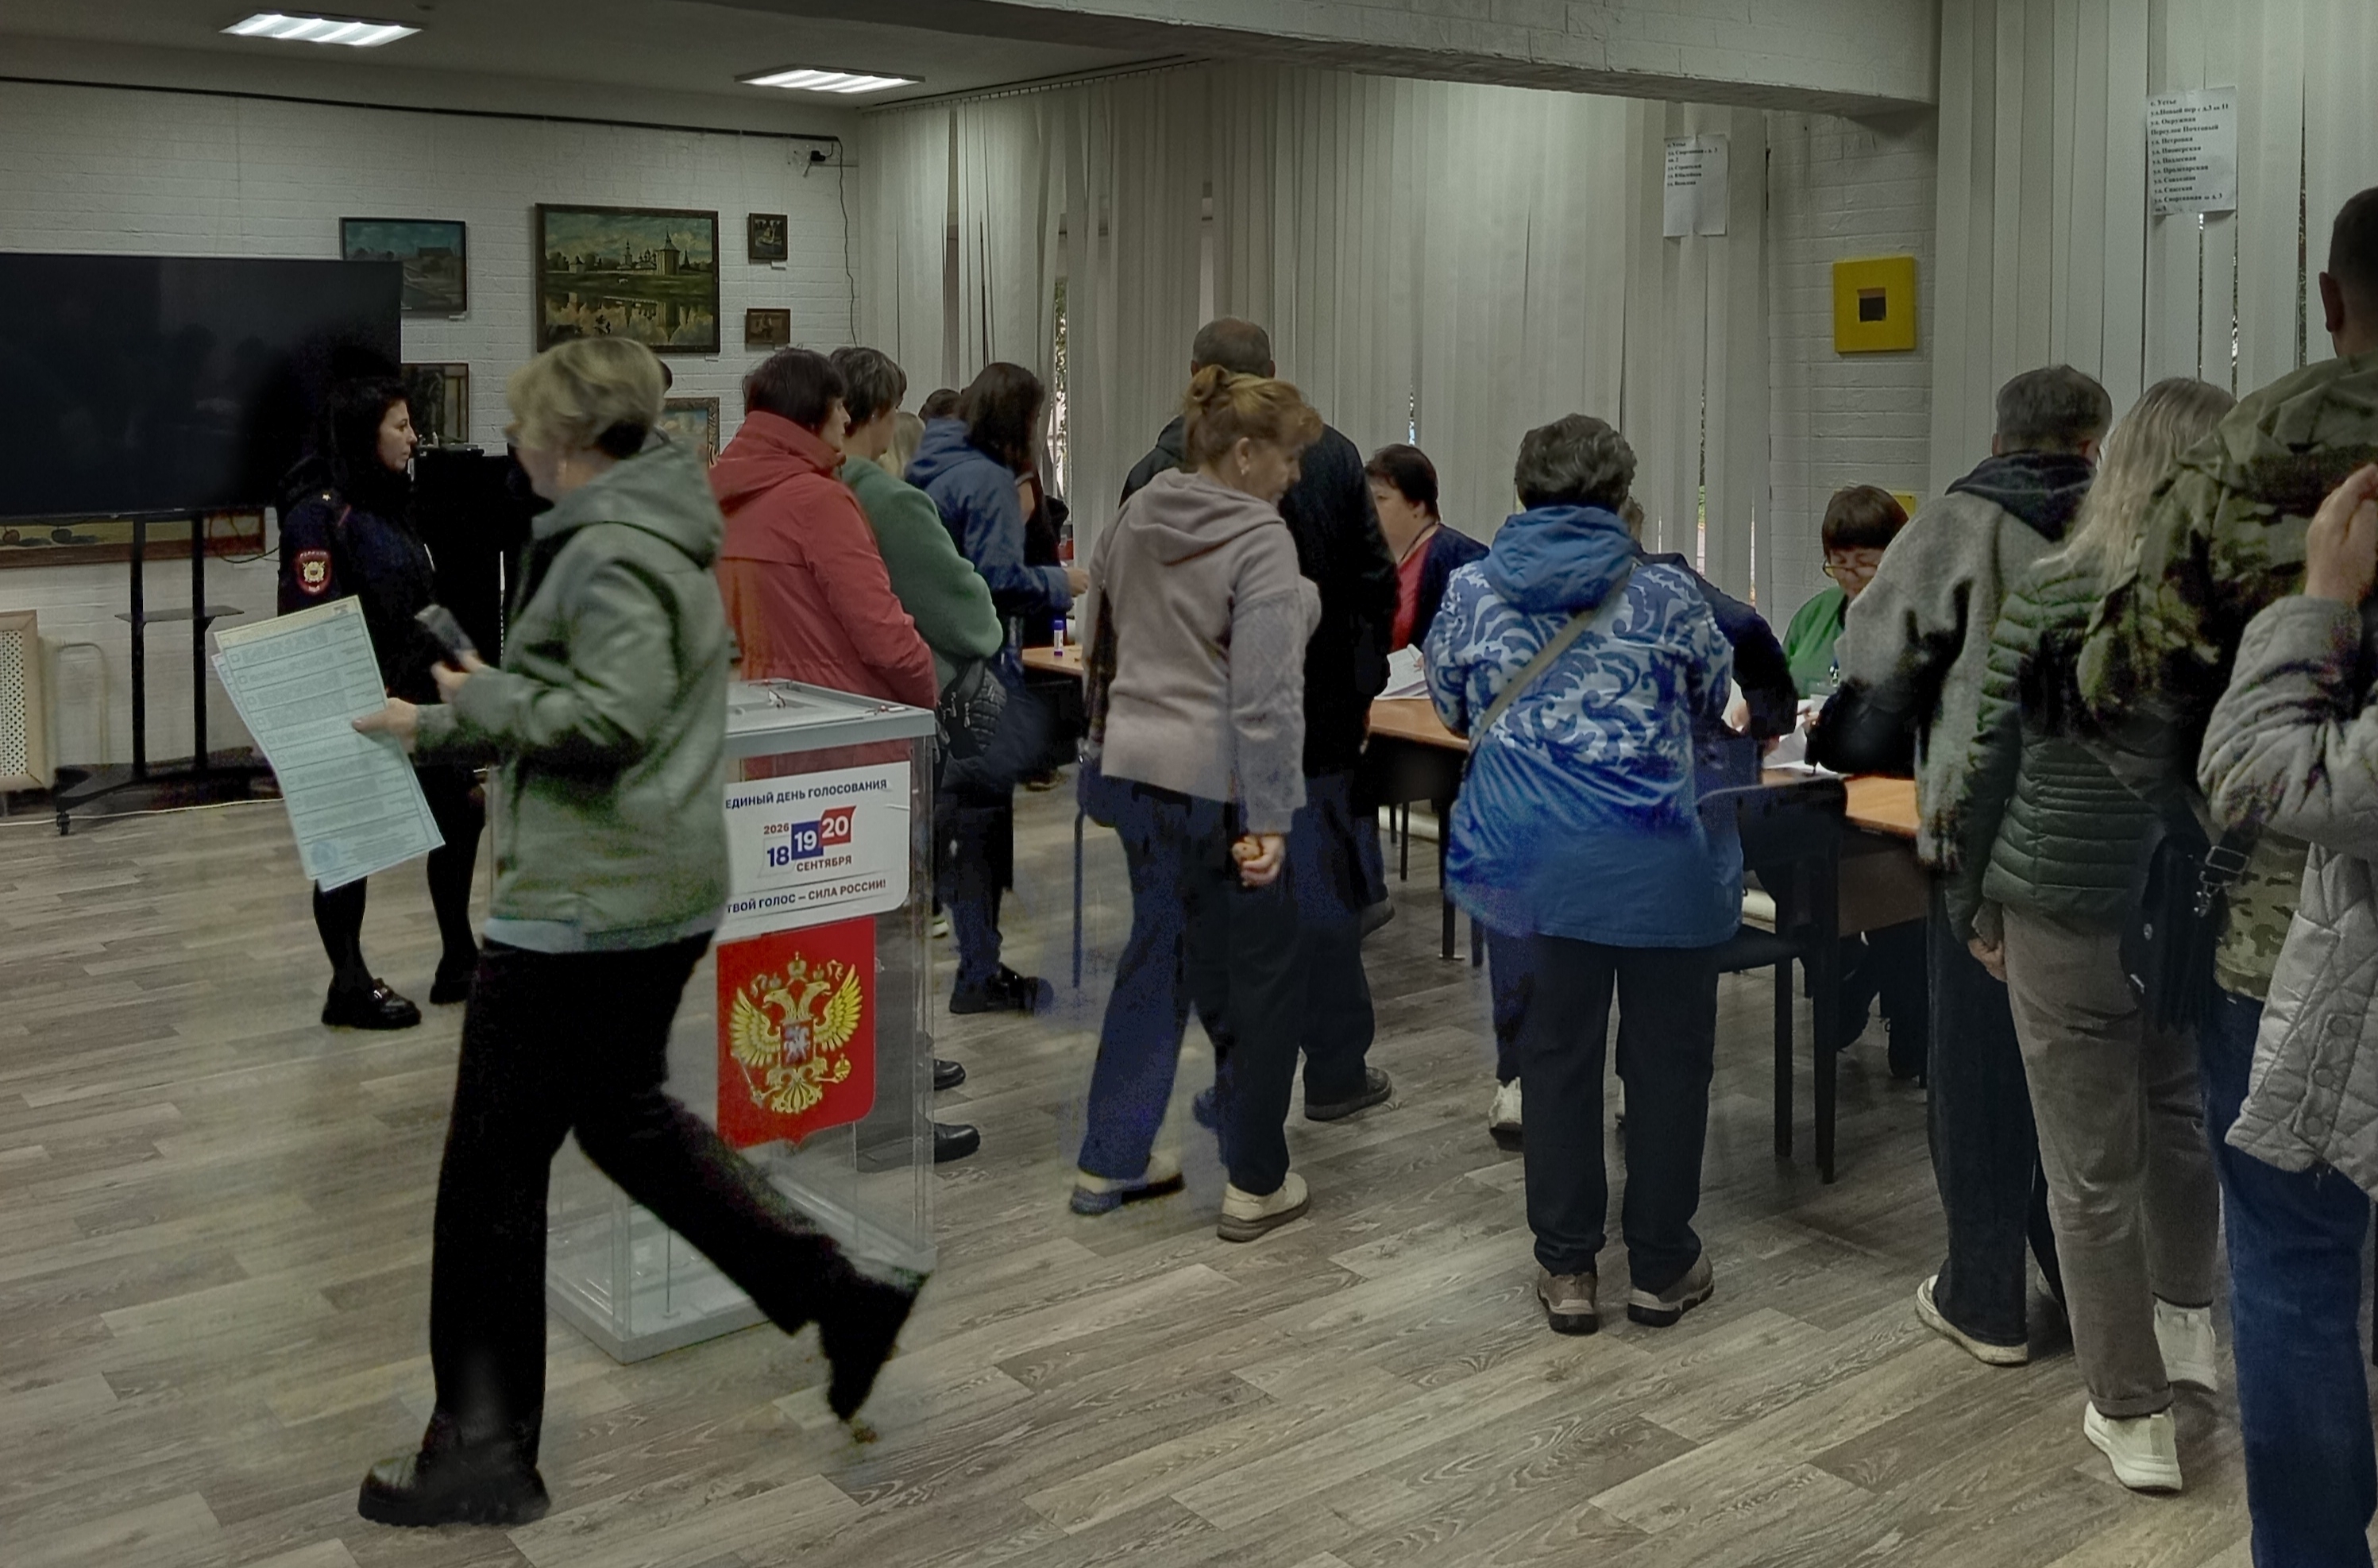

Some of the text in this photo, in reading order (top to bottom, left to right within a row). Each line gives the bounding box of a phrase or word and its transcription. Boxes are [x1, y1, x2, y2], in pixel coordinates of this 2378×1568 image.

[2164, 165, 2208, 174] Пролетарская
[725, 779, 887, 809] ЕДИНЫЙ ДЕНЬ ГОЛОСОВАНИЯ
[763, 823, 789, 834] 2026
[766, 816, 849, 867] 18 19 20
[796, 855, 852, 872] СЕНТЯБРЯ
[727, 898, 756, 913] ТВОЙ
[759, 894, 795, 909] ГОЛОС
[808, 887, 837, 901] СИЛА
[840, 879, 886, 895] РОССИИ!
